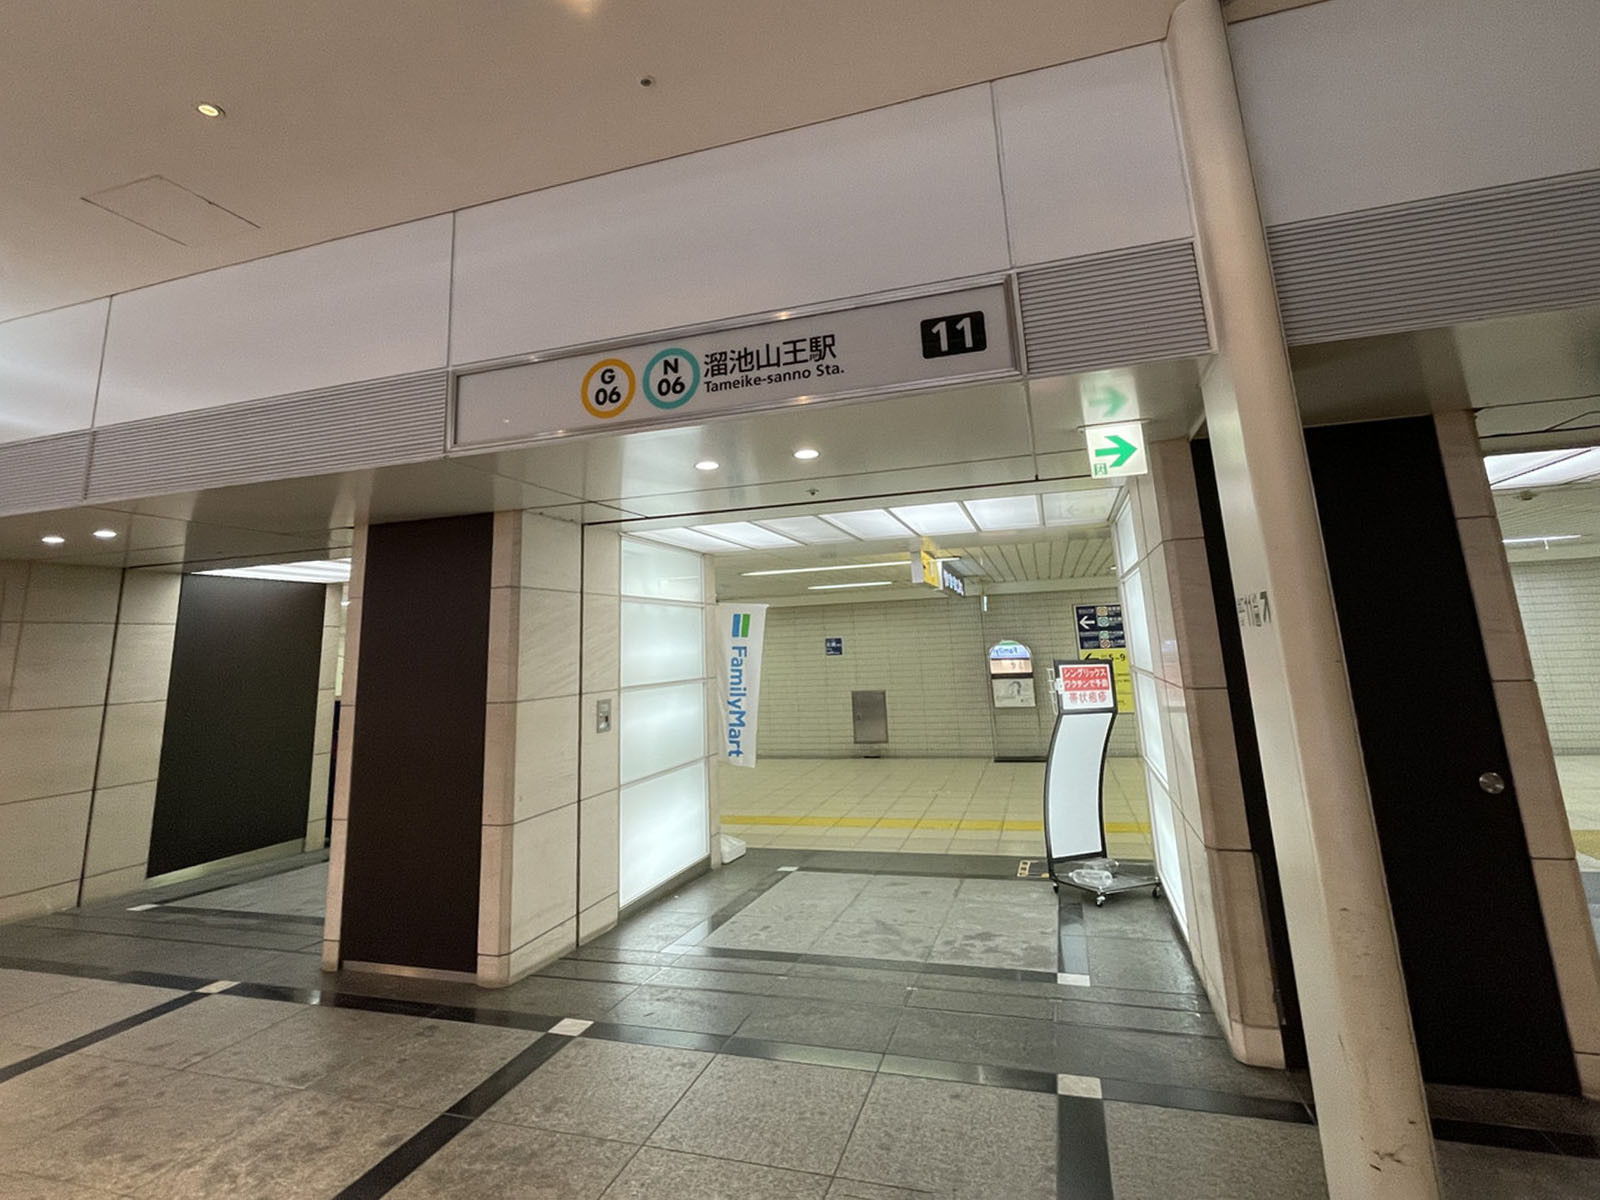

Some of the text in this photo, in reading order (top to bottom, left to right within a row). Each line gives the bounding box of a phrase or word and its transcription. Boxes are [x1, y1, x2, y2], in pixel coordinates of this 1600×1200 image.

[932, 317, 972, 351] 11
[663, 357, 679, 376] N
[703, 334, 837, 378] 溜池山王駅
[600, 368, 616, 385] G
[658, 376, 686, 397] 06
[704, 364, 845, 393] Tameike-sanno Sta.
[594, 386, 622, 406] 06
[727, 646, 748, 757] FamilyMart
